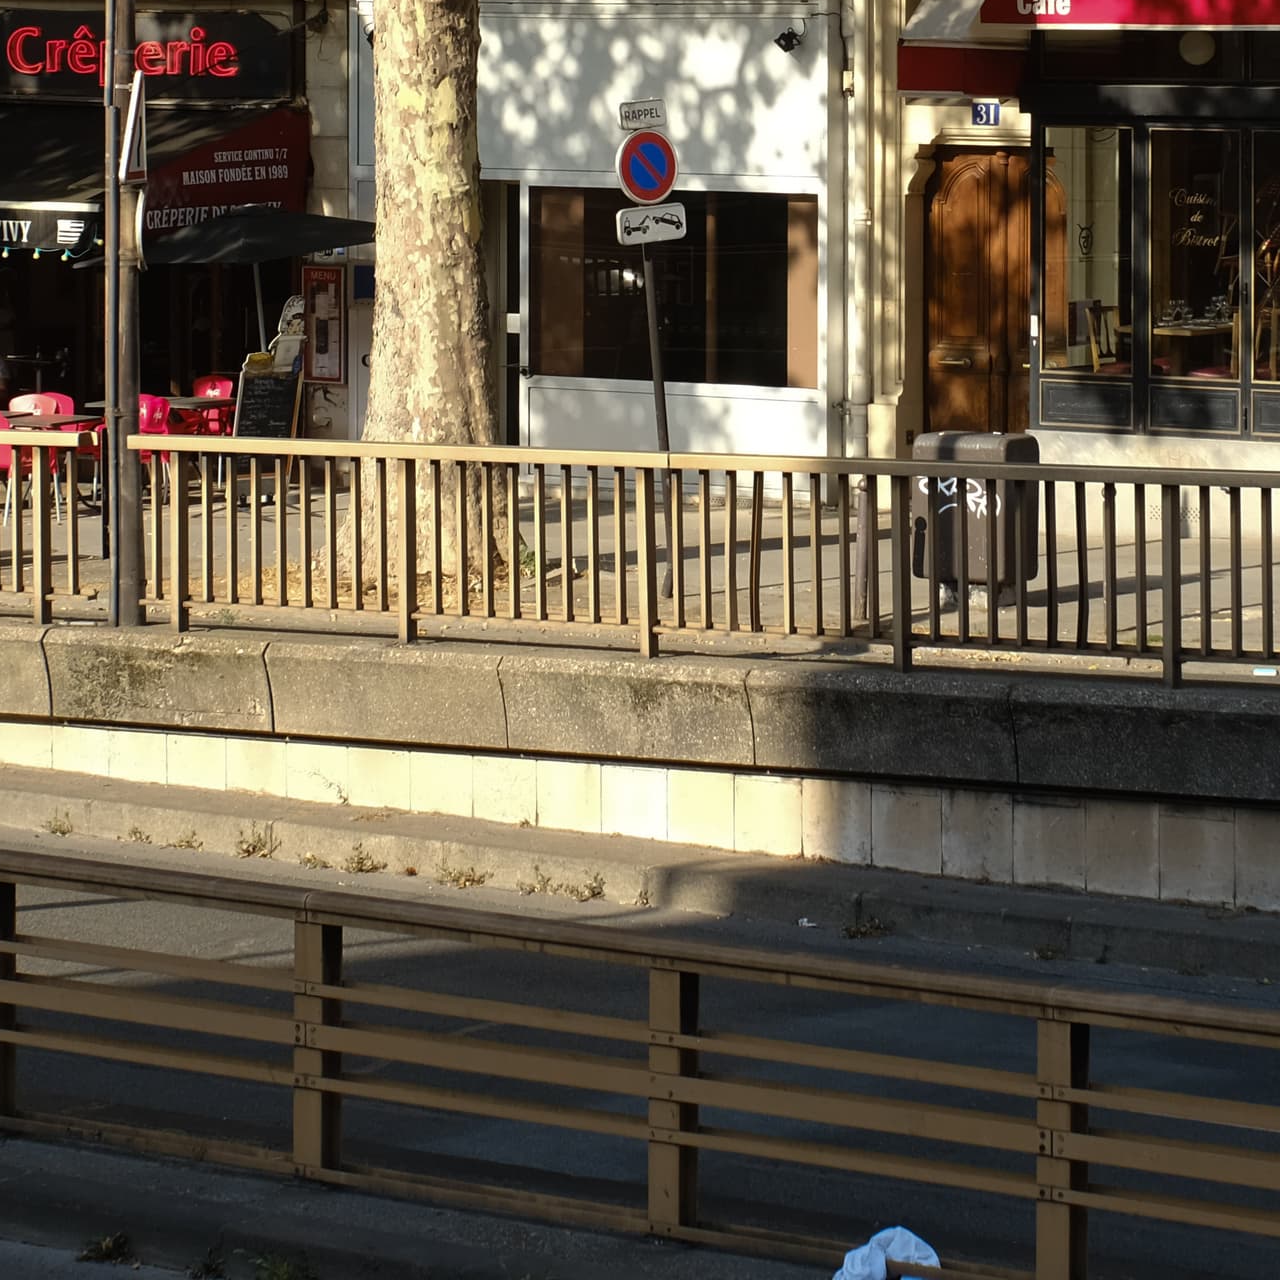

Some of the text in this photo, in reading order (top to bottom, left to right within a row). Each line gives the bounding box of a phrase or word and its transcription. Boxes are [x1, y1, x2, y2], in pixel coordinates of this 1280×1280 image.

[624, 107, 661, 121] RAPPEL
[976, 104, 995, 125] 31
[213, 148, 288, 163] SERVICE CONTINU 7/7
[182, 164, 289, 186] MAISON FONDÉE EN 1989
[1190, 210, 1204, 223] de
[1175, 227, 1220, 247] Bistrot
[310, 270, 337, 281] MENU
